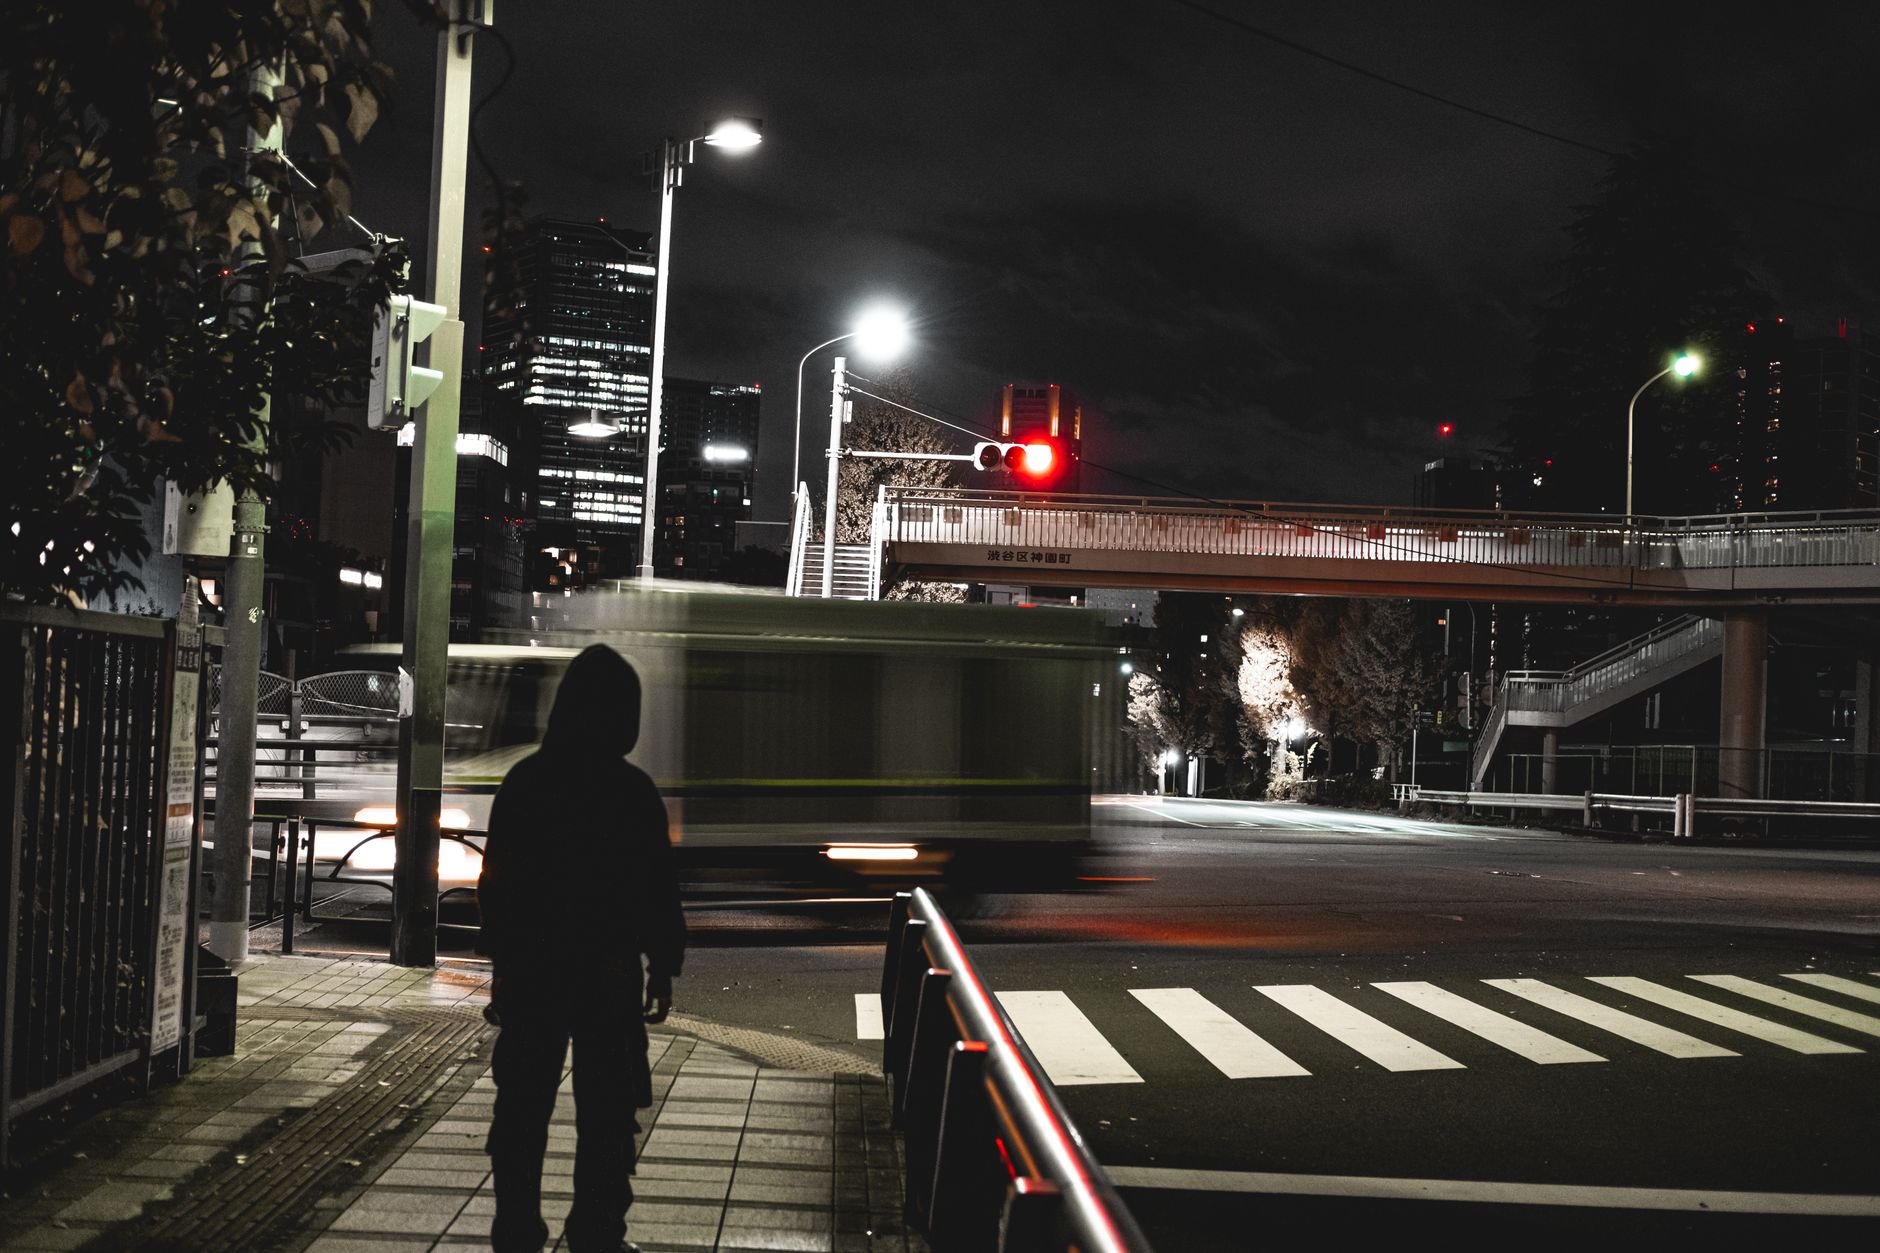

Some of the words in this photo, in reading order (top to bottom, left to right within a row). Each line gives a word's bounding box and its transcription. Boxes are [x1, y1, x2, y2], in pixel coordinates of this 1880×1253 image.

[987, 550, 1072, 564] 渋谷区神園町
